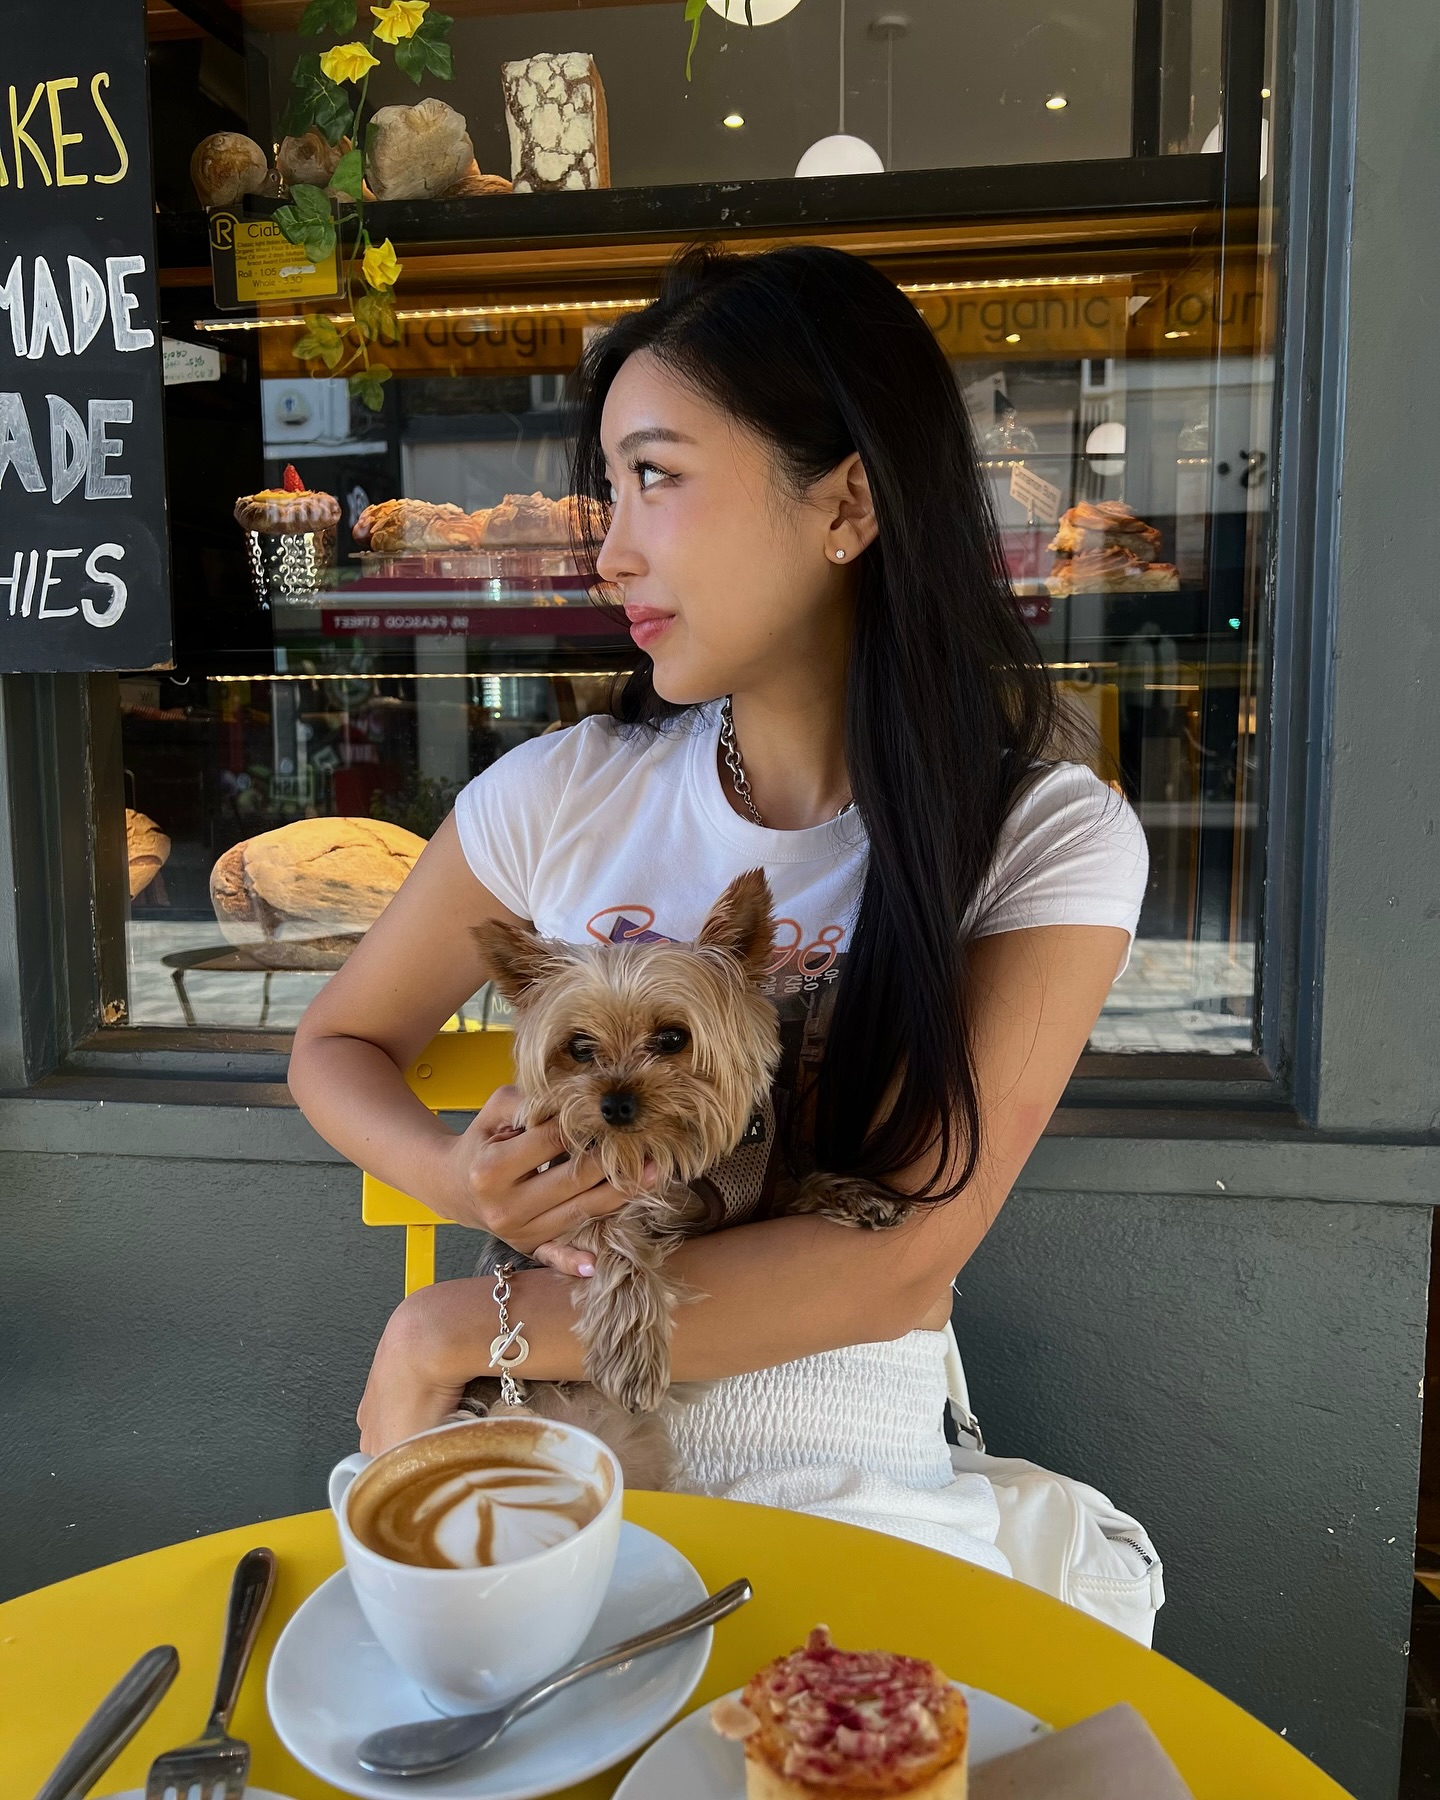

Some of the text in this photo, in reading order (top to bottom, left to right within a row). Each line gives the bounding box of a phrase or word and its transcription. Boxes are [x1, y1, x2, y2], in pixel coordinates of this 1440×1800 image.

[0, 72, 129, 189] KES
[238, 270, 252, 278] Roll
[253, 279, 275, 288] Whole
[284, 276, 303, 285] 3.30
[308, 298, 566, 358] ourdough
[919, 281, 1263, 343] Organic Flour
